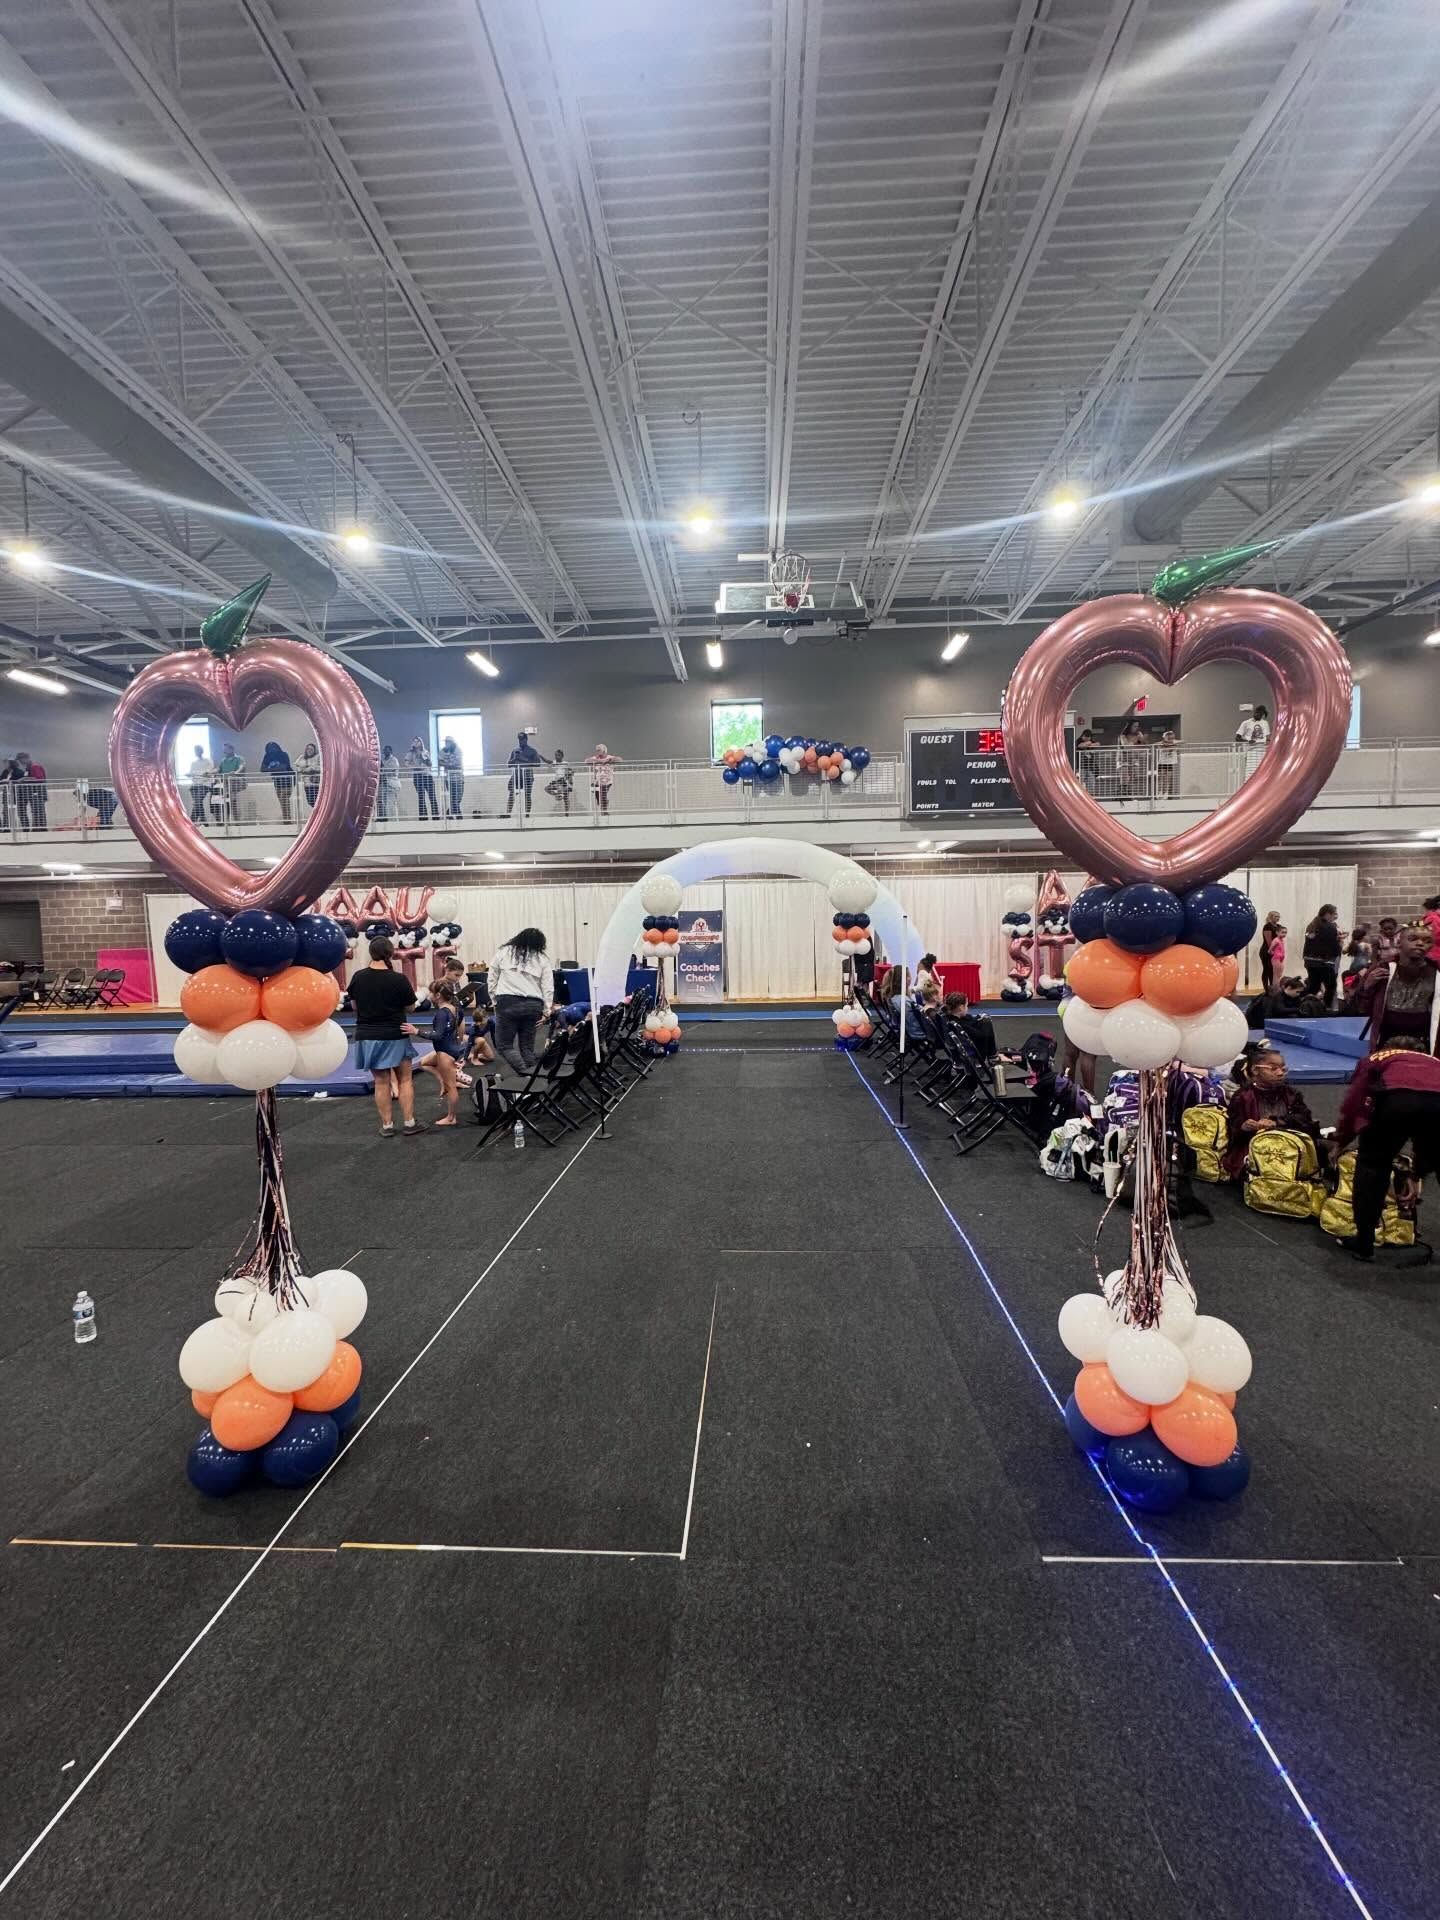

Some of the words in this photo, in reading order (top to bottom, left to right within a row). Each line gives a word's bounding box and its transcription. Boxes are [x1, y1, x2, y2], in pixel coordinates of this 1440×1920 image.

[920, 735, 954, 744] GUEST
[967, 761, 997, 769] PERIOD
[970, 777, 1011, 785] PLAYER-FOU
[680, 963, 720, 972] Coaches
[686, 974, 715, 982] Check
